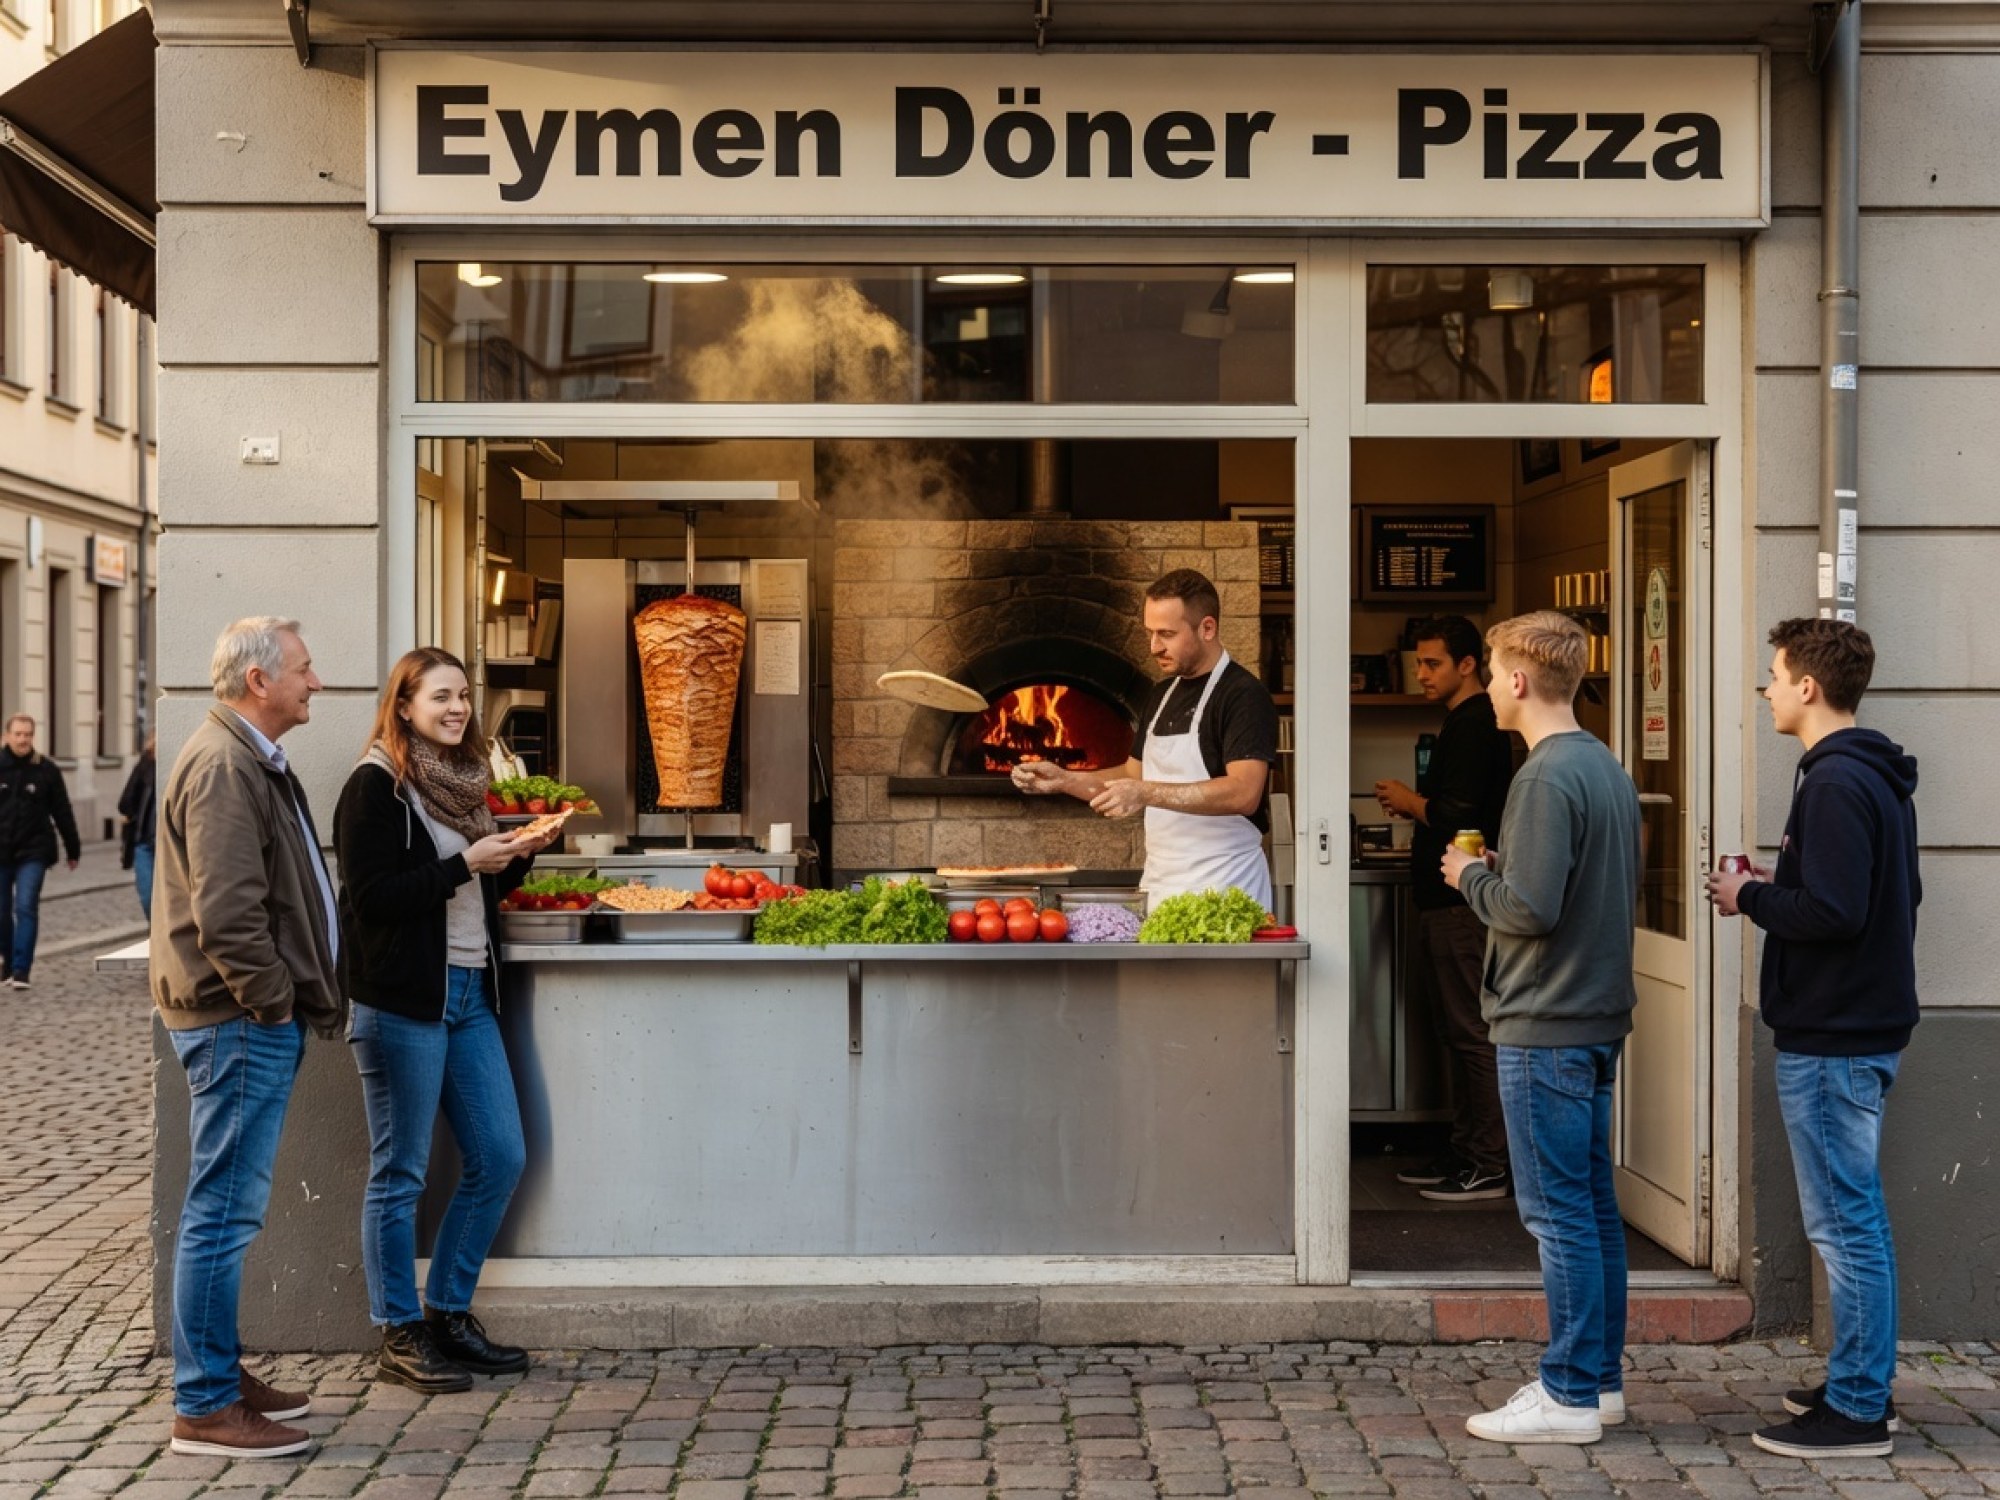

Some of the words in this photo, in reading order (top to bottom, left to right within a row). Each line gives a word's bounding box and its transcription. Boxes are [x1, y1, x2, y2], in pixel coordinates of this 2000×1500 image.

[416, 84, 841, 202] Eymen
[895, 86, 1277, 180] Döner
[1312, 134, 1350, 156] -
[1396, 87, 1723, 181] Pizza
